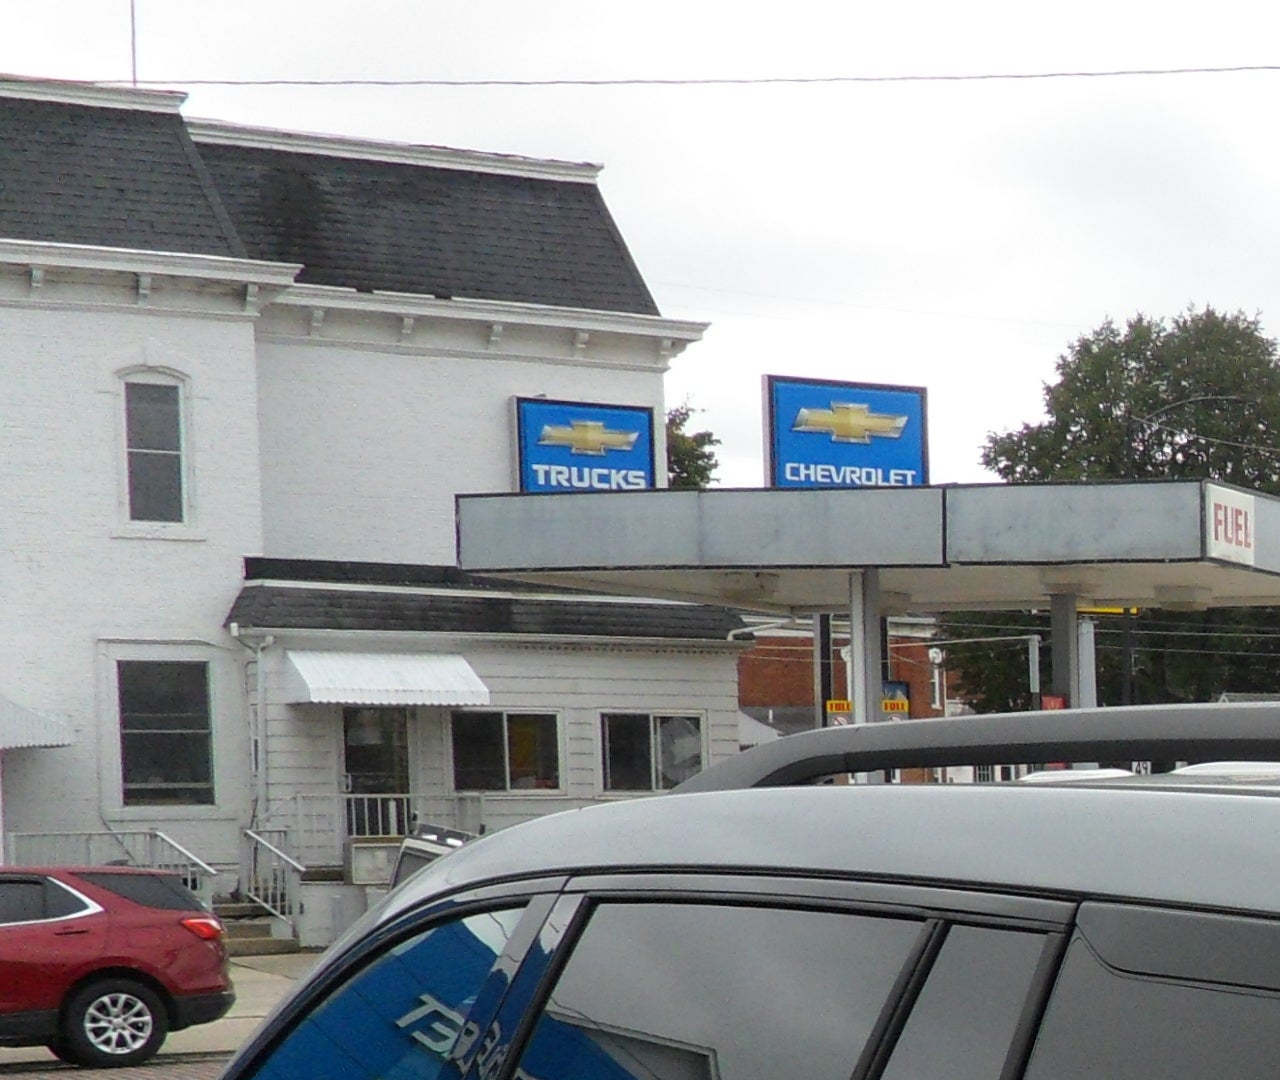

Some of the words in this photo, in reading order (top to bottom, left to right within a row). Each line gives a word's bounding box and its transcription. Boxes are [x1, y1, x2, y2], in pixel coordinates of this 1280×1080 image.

[532, 464, 647, 490] TRUCKS
[784, 462, 916, 487] CHEVROLET
[1214, 502, 1252, 549] FUEL
